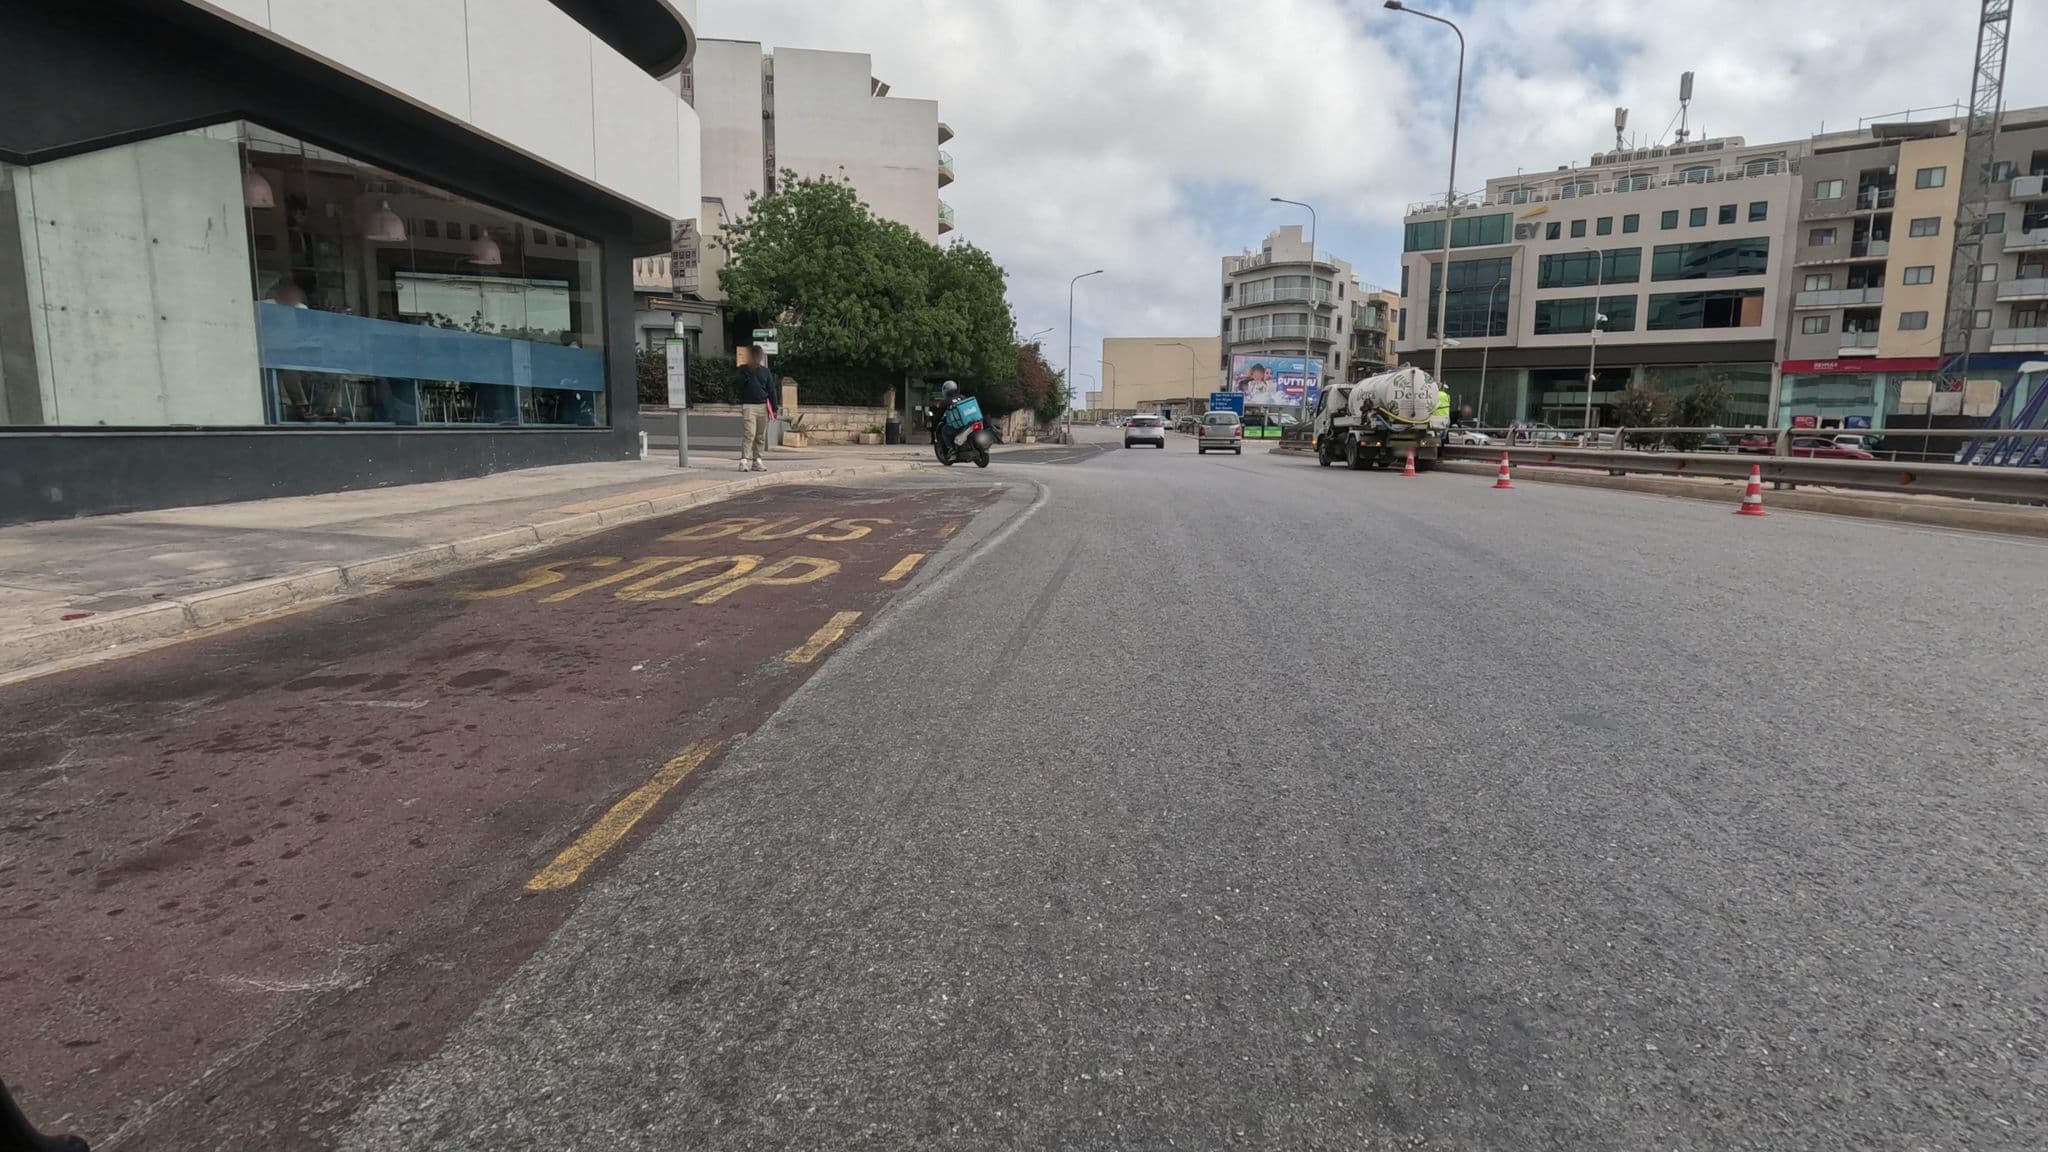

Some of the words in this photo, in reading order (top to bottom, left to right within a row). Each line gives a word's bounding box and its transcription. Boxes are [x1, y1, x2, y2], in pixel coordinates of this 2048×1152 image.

[1515, 221, 1541, 240] EY
[1394, 389, 1433, 400] Derek
[656, 517, 896, 541] BUS
[452, 554, 842, 604] STOP
